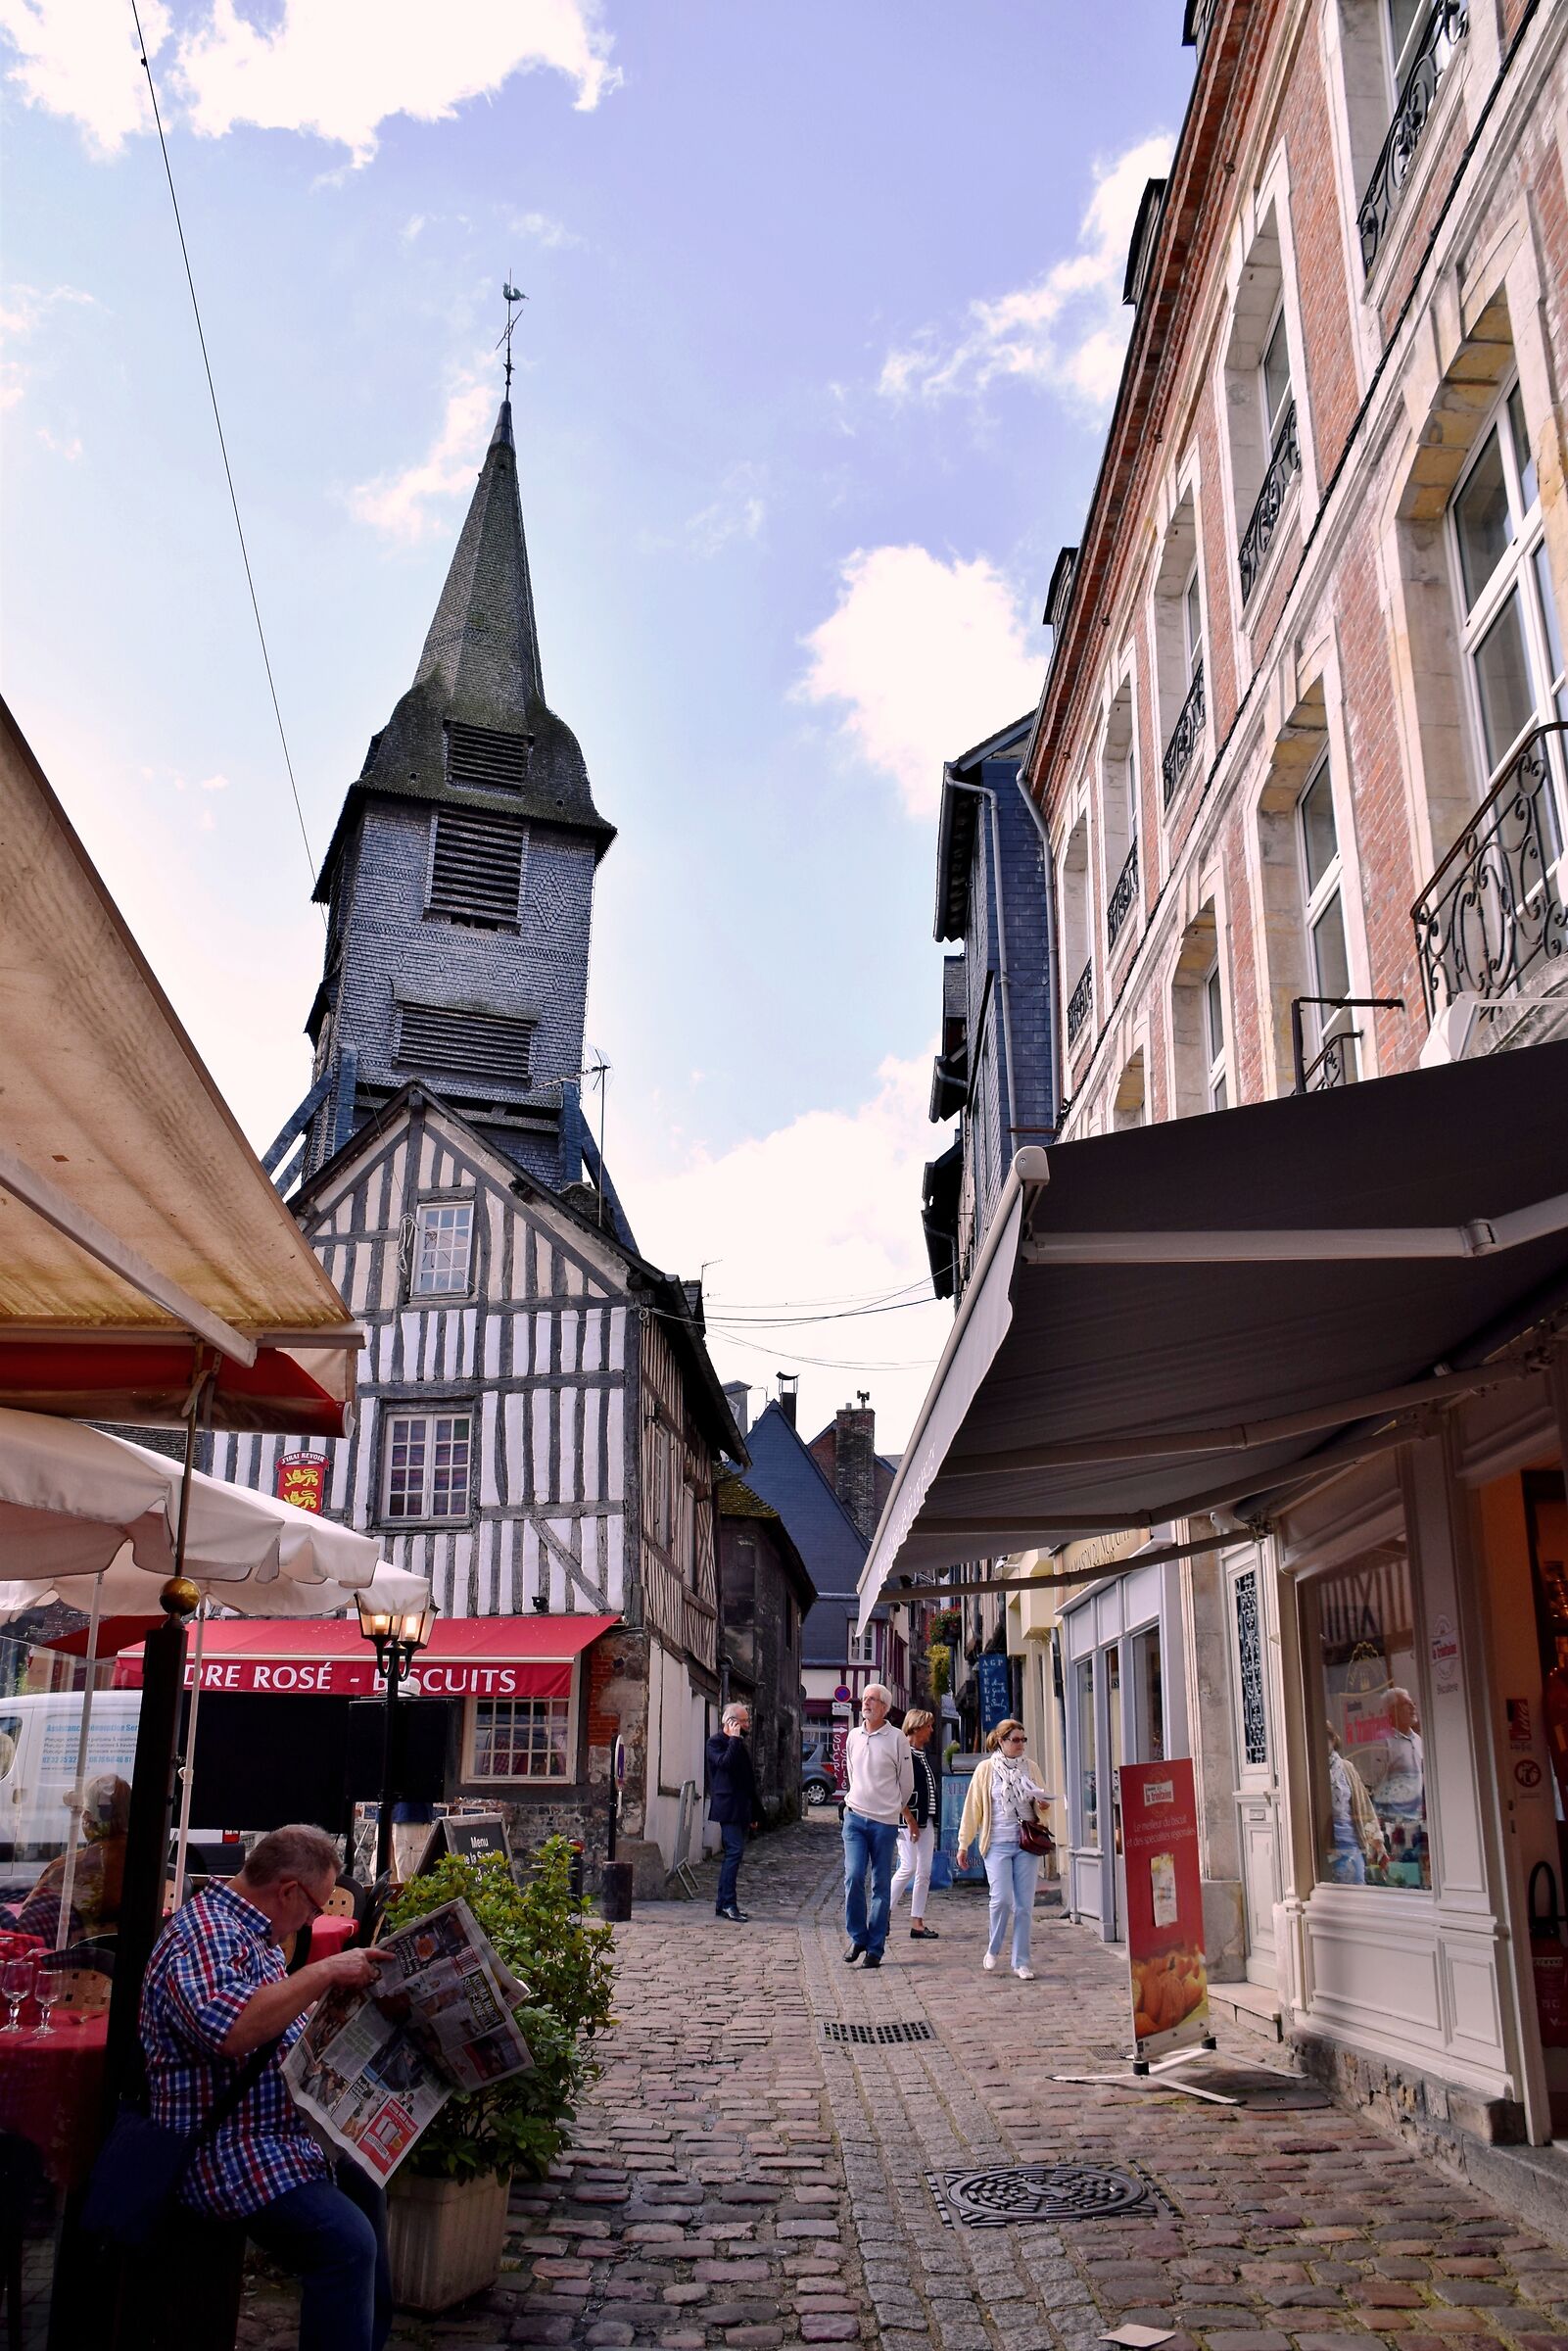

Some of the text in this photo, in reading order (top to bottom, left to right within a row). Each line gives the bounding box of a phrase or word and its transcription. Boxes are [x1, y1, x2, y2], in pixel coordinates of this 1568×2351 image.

[301, 1452, 325, 1463] REVOIR
[253, 1661, 332, 1690] ROSÉ
[1134, 1822, 1141, 1832] Le
[470, 1837, 489, 1848] Menu
[470, 1852, 477, 1864] la
[472, 1974, 488, 2000] KOMA
